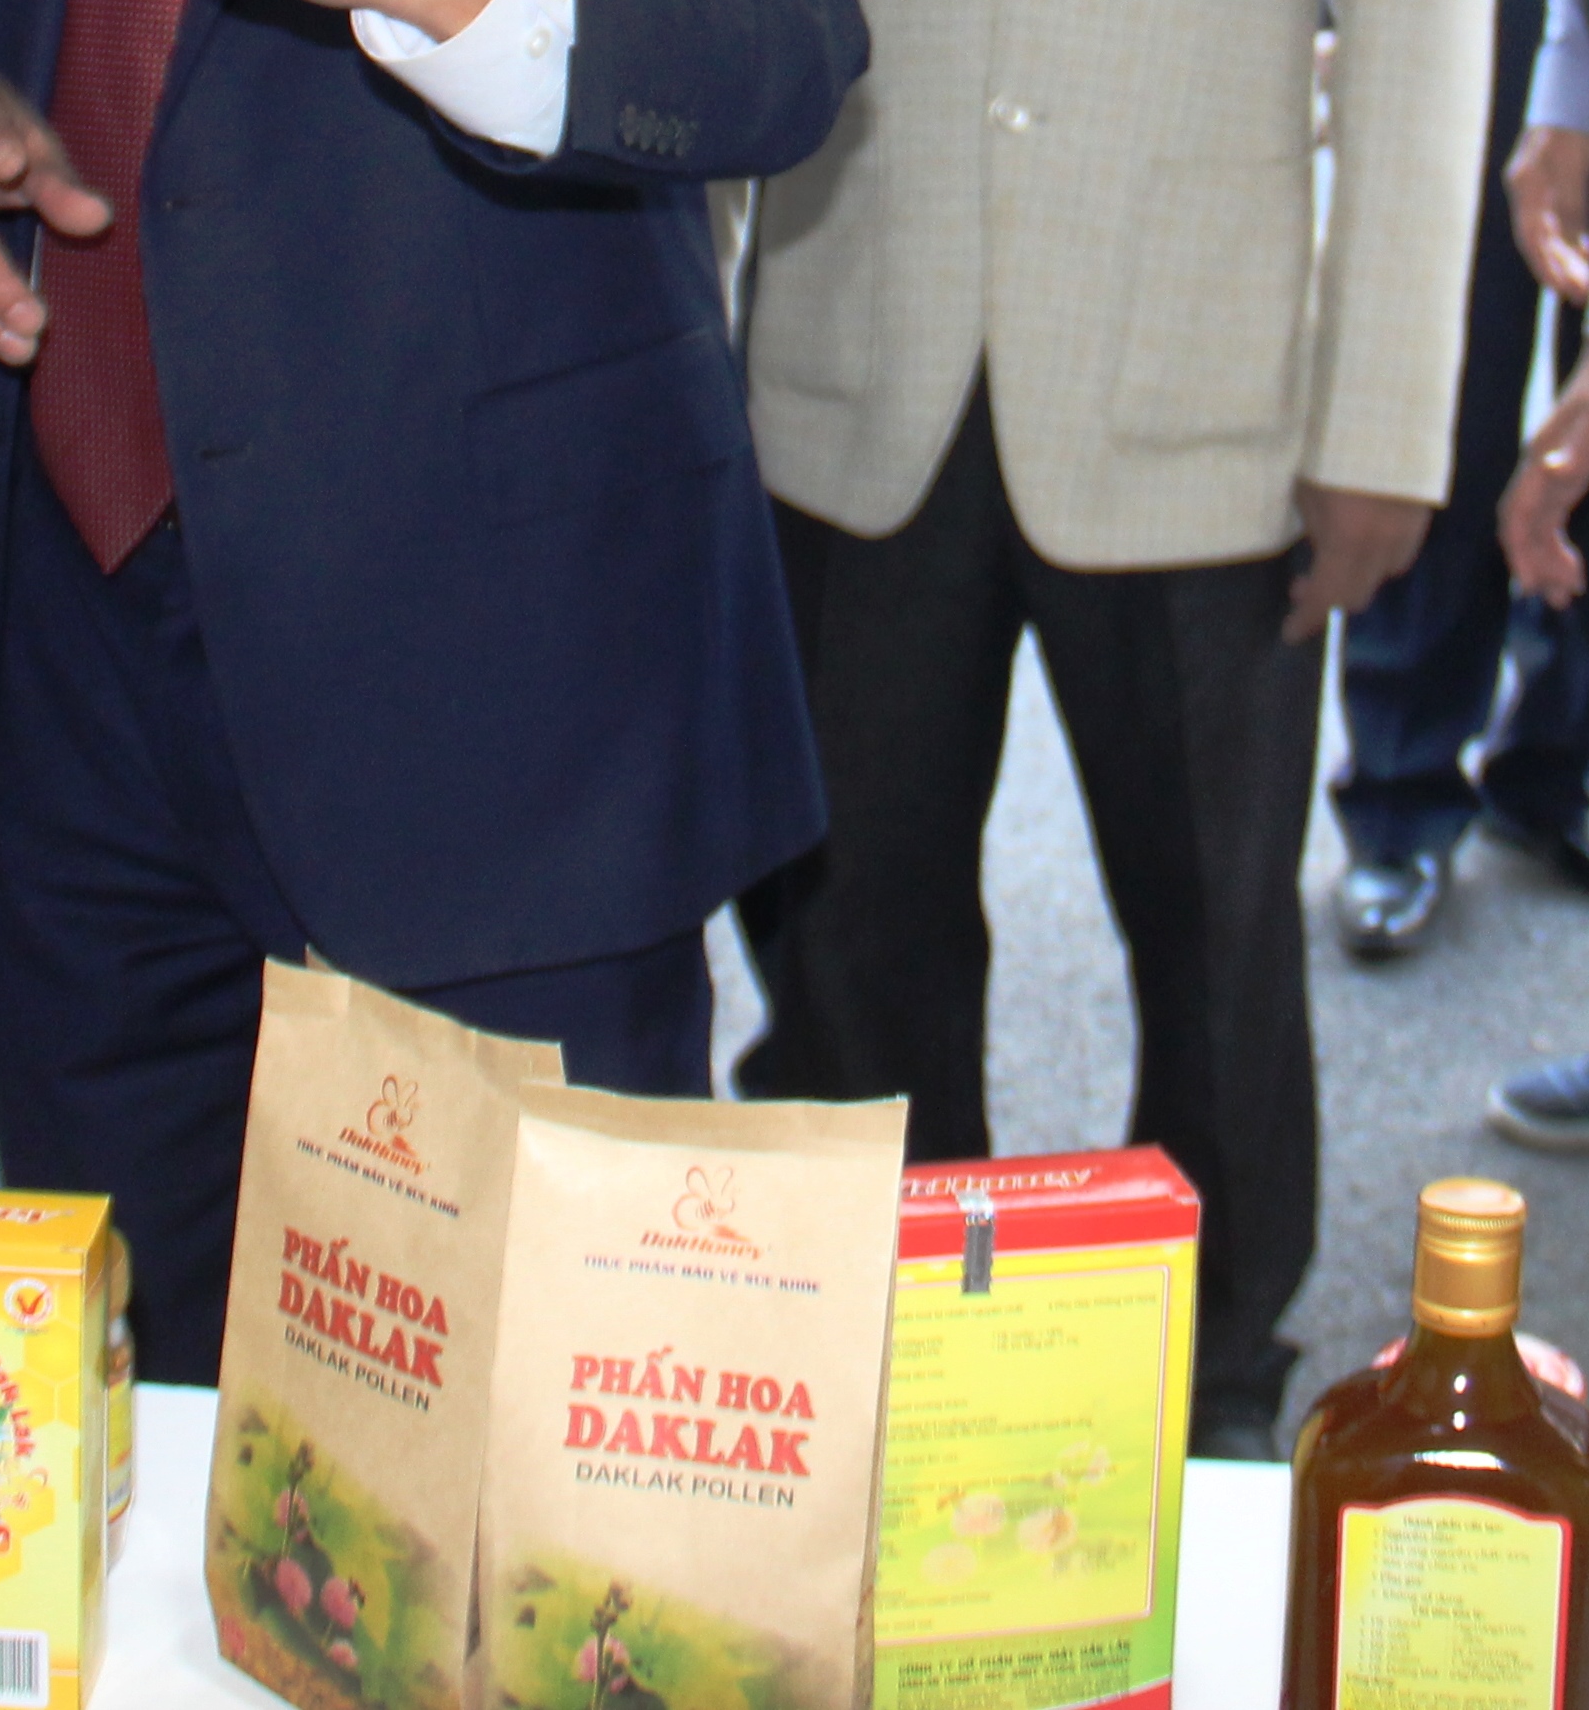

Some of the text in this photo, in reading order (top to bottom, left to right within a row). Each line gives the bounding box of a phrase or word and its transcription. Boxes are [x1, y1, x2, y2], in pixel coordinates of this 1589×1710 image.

[281, 1223, 450, 1337] PHẤN HOA
[640, 1229, 763, 1261] DakHoney
[277, 1268, 444, 1391] DAKLAK
[282, 1322, 431, 1414] DAKLAK POLLEN
[569, 1343, 816, 1422] PHẤN HOA
[10, 1407, 37, 1460] Lak
[562, 1402, 812, 1479] DAKLAK
[574, 1459, 796, 1509] DAKLAK POLLEN
